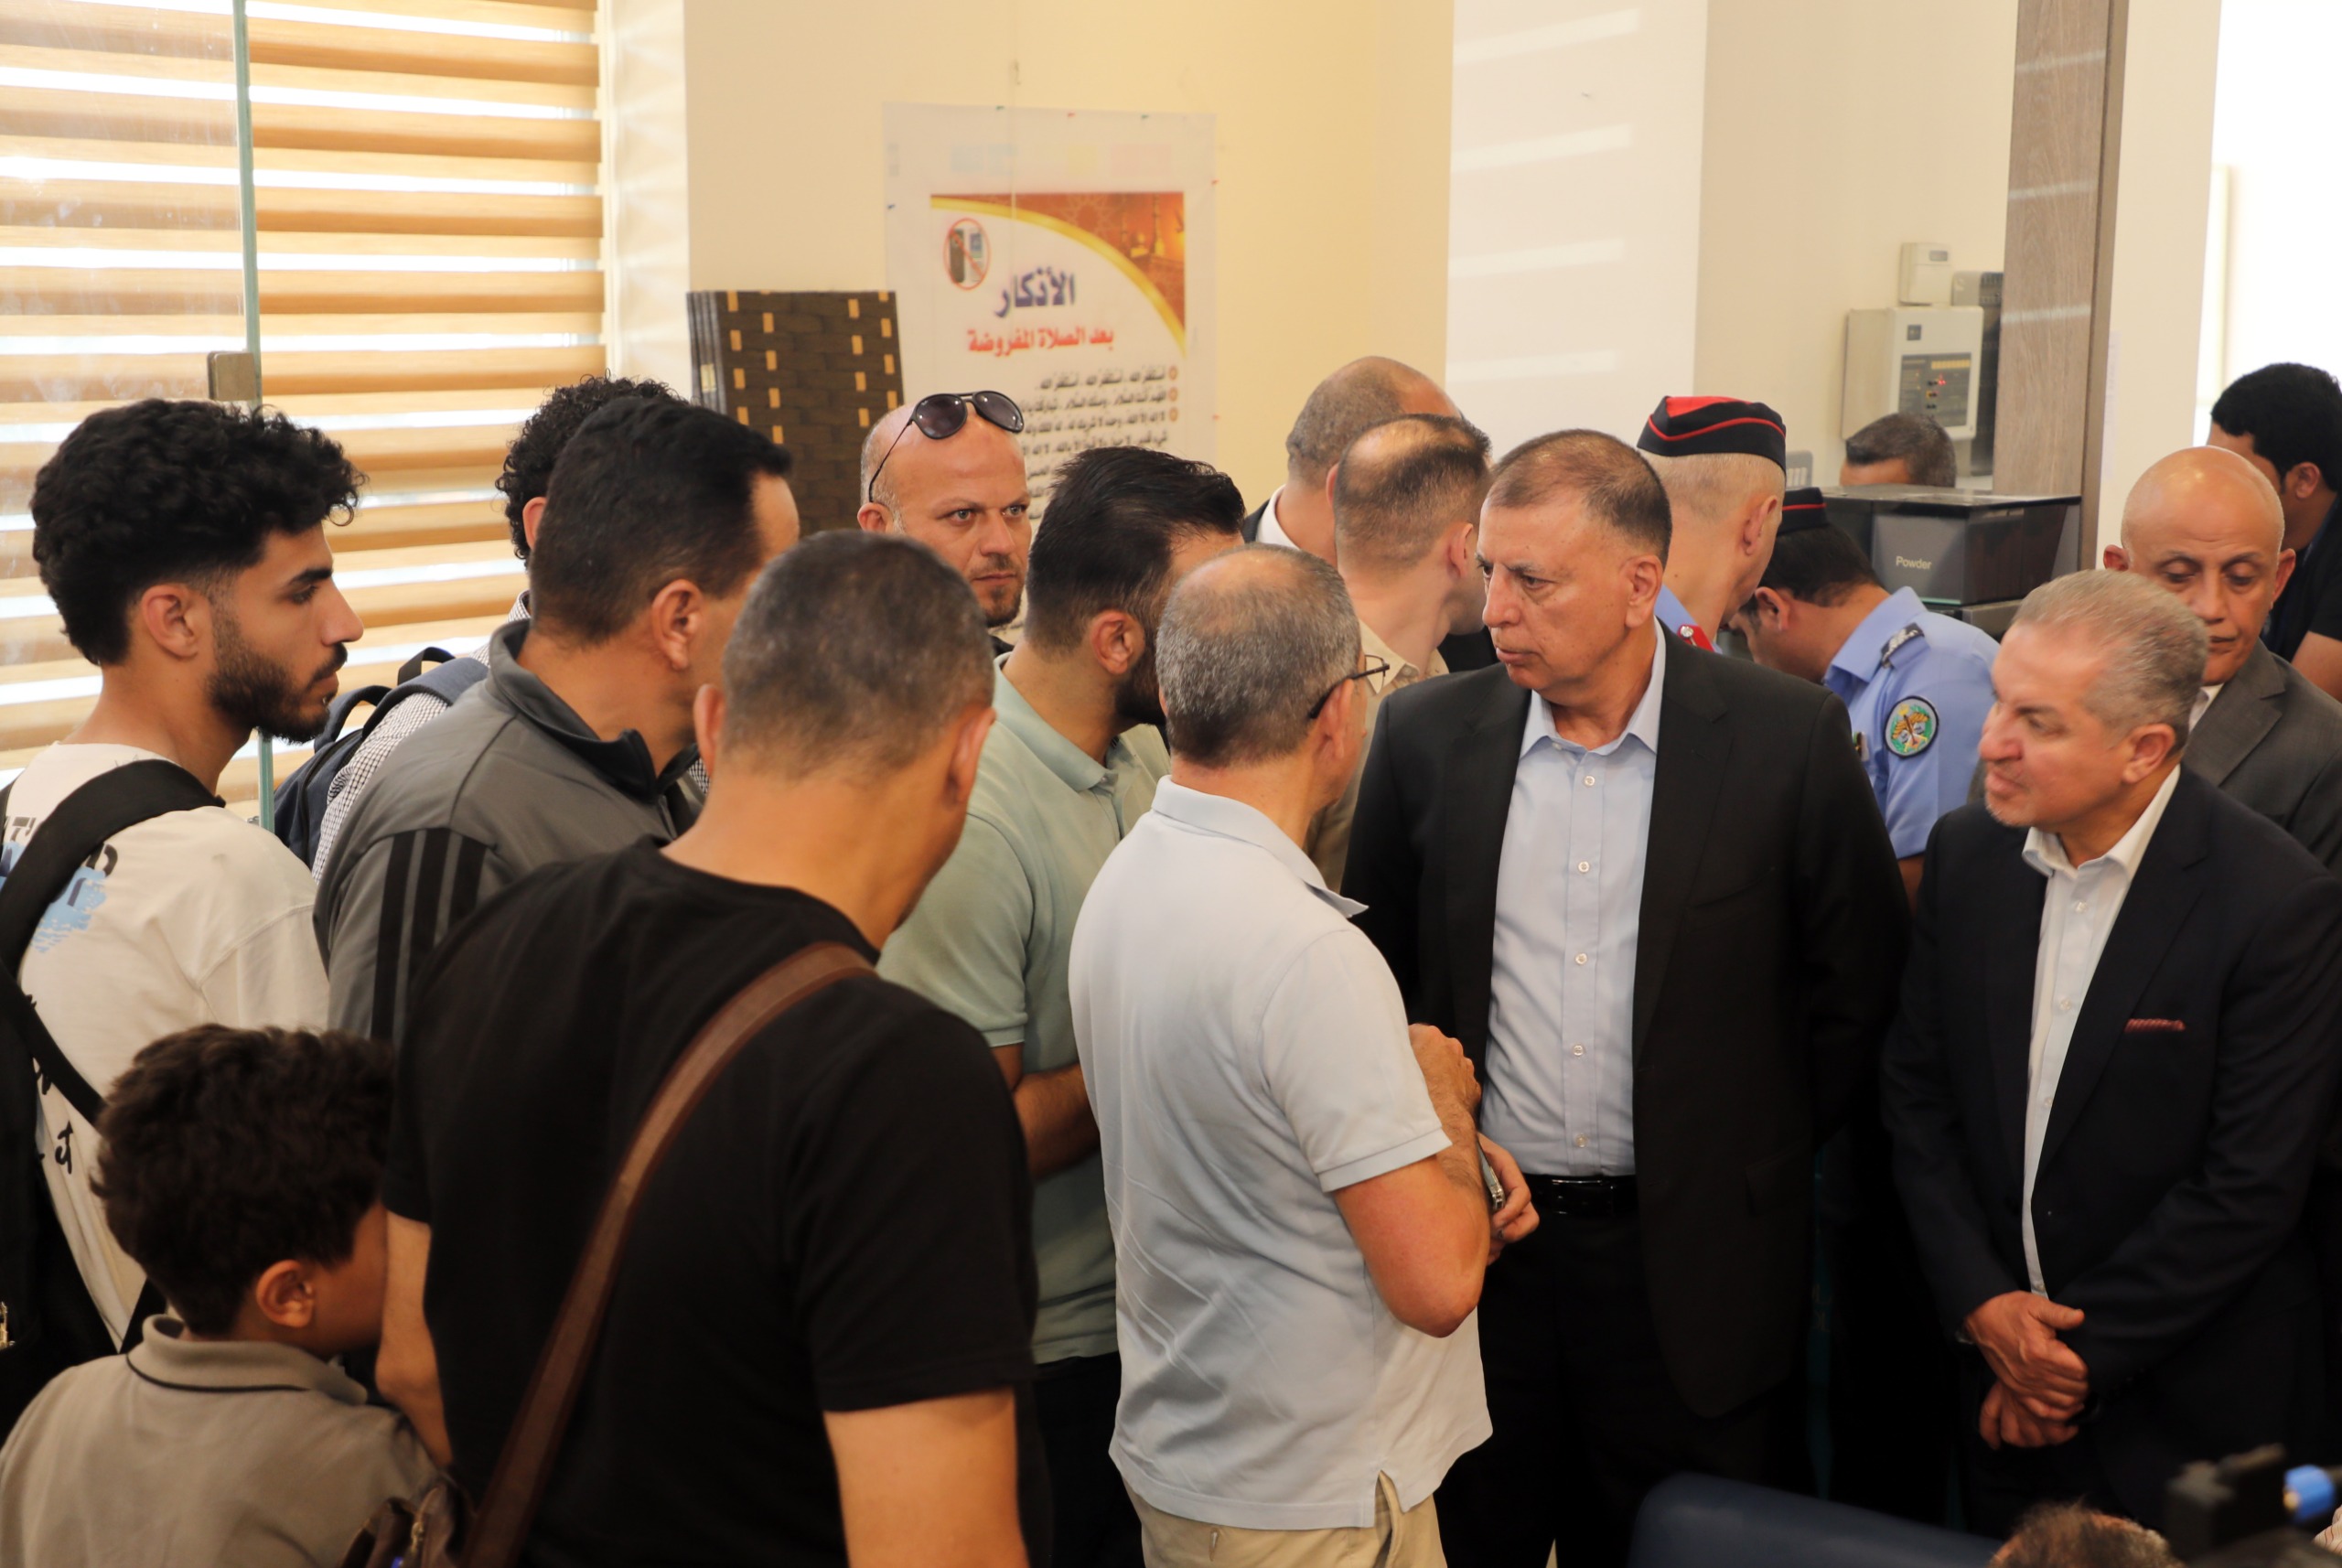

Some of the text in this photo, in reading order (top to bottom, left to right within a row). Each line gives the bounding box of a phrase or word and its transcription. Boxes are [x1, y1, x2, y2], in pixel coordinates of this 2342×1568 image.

[994, 265, 1076, 317] الأذكار
[967, 324, 1114, 358] بعد الصلاة المفروضة
[1896, 555, 1933, 570] Powder
